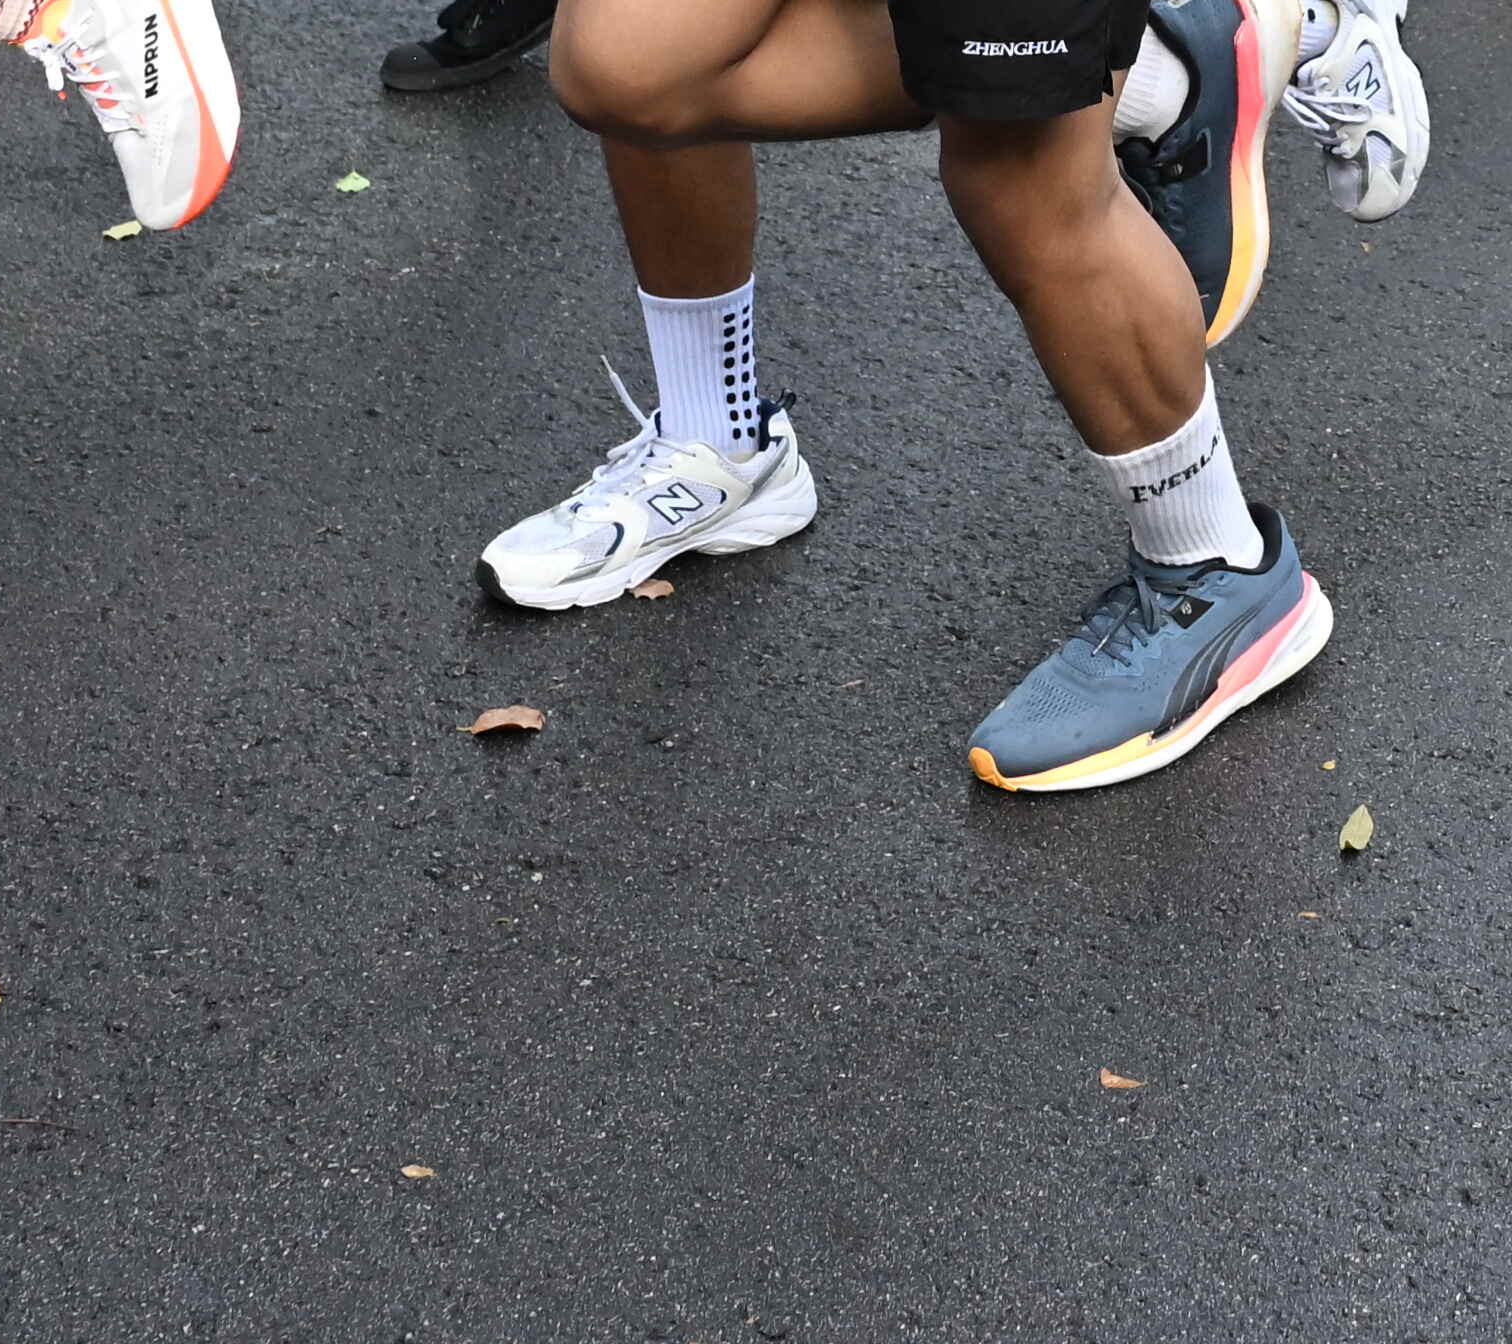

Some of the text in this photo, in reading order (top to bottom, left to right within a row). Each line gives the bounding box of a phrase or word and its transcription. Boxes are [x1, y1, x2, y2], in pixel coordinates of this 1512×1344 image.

[144, 14, 158, 99] KIPRUN
[961, 39, 1069, 57] ZHENGHUA
[1129, 424, 1221, 503] EVERLA
